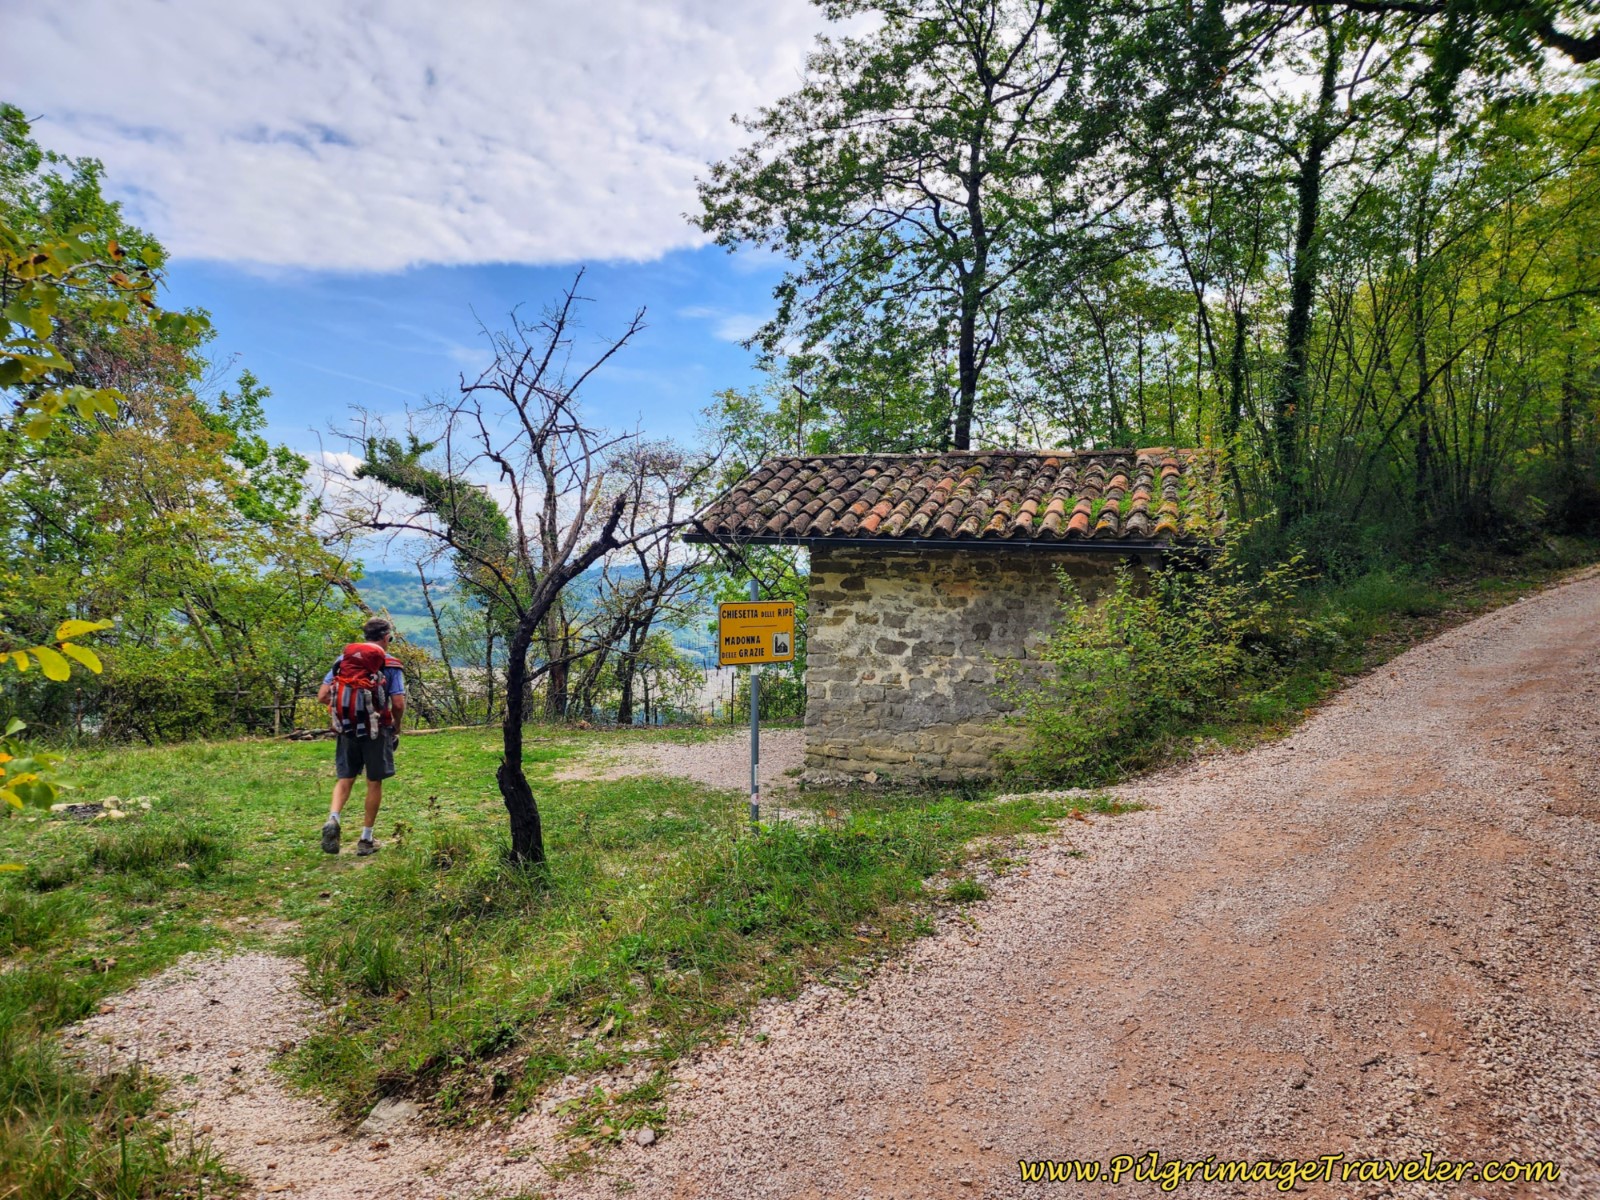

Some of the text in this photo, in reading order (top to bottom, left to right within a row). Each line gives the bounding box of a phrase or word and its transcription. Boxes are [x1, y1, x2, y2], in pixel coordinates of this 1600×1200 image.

[722, 610, 758, 618] CHIESETTA
[778, 608, 792, 616] RIPE
[724, 636, 760, 646] MADONNA
[738, 648, 764, 658] GRAZIE
